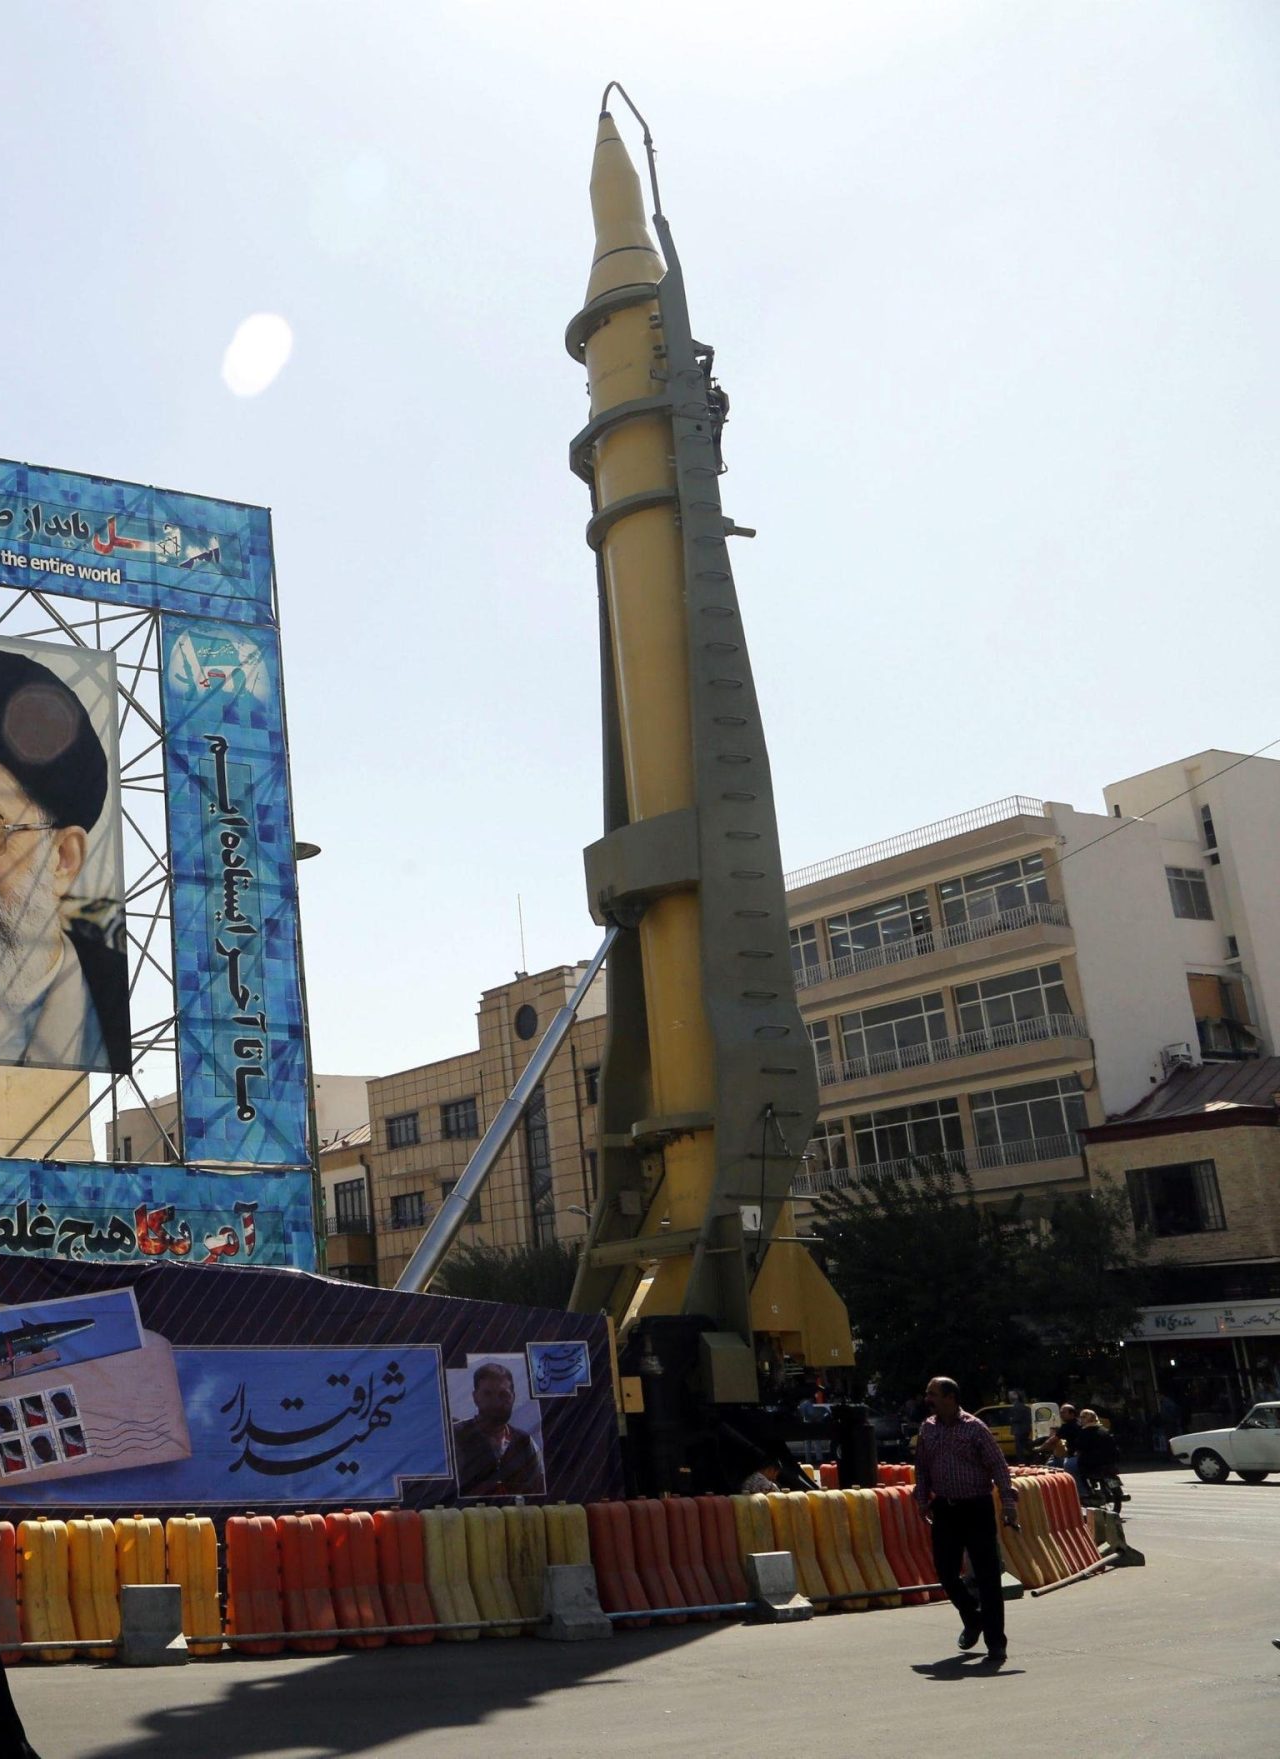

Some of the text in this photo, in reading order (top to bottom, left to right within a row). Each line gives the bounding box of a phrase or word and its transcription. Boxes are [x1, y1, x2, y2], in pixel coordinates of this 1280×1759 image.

[16, 504, 42, 541] از
[43, 511, 91, 548] باید
[0, 549, 28, 568] the
[29, 556, 75, 578] entire
[77, 565, 121, 585] world
[214, 937, 268, 1034] آخر
[233, 1037, 265, 1061] تا
[235, 1066, 267, 1122] ما
